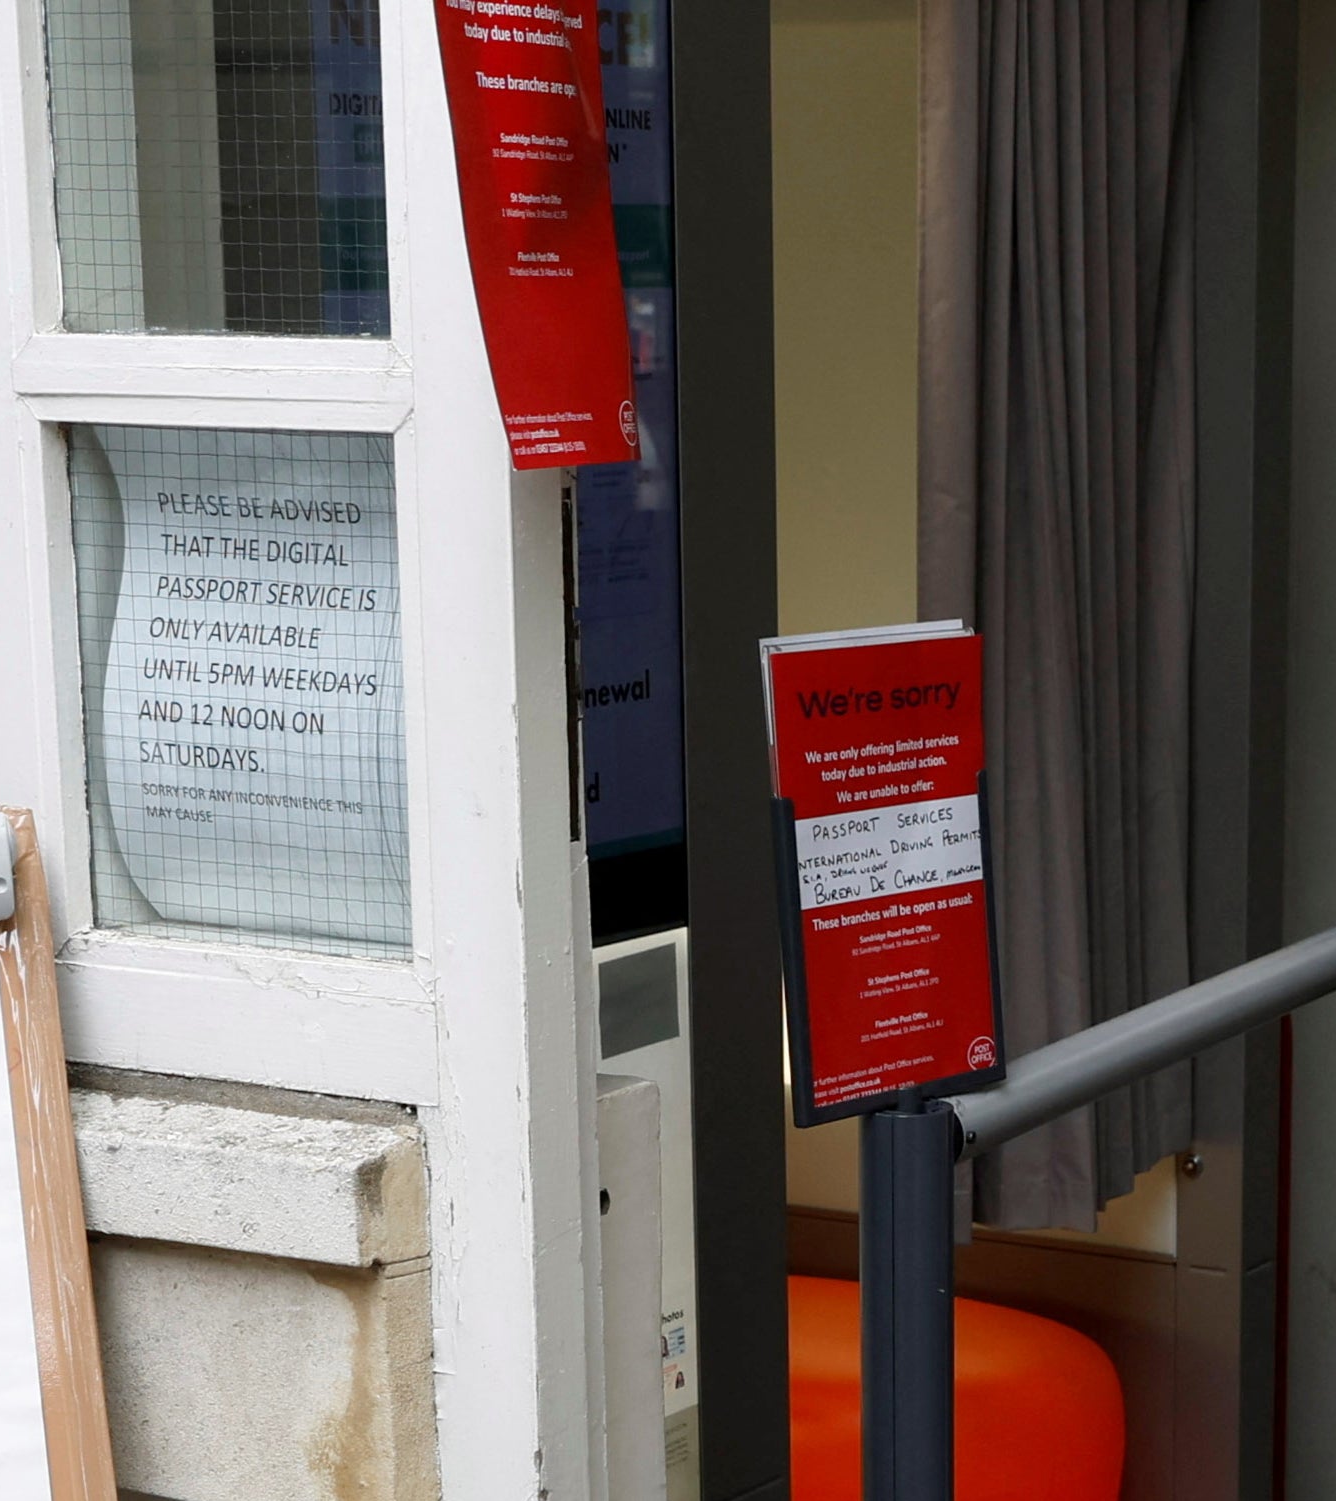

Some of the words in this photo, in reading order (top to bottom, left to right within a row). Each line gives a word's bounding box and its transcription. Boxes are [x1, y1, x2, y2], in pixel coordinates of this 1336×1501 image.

[477, 0, 532, 18] experience
[534, 4, 561, 24] delays
[464, 22, 489, 43] today
[491, 25, 511, 42] due
[513, 28, 525, 43] to
[526, 28, 564, 48] industrial
[475, 71, 505, 89] These
[507, 74, 549, 92] branches
[550, 82, 563, 95] are
[605, 107, 652, 131] NLINE
[157, 492, 232, 517] PLEASE
[237, 496, 264, 519] BE
[270, 499, 362, 525] ADVISED
[161, 533, 215, 558] THAT
[221, 537, 260, 561] THE
[267, 540, 349, 566] DIGITAL
[157, 576, 263, 604] PASSPORT
[266, 582, 352, 610] SERVICE
[357, 589, 377, 612] IS
[149, 616, 203, 641] ONLY
[207, 621, 321, 650] AVAILABLE
[143, 658, 203, 683] UNTIL
[208, 663, 255, 687] 5PM
[262, 665, 378, 696] WEEKDAYS
[584, 669, 650, 709] newal
[797, 687, 884, 719] We're
[890, 682, 961, 710] sorry
[138, 700, 183, 723] AND
[190, 703, 214, 726] 12
[220, 705, 285, 732] NOON
[292, 711, 325, 735] ON
[139, 740, 265, 773] SATURDAYS.
[804, 750, 821, 764] We
[823, 751, 838, 761] are
[839, 746, 859, 760] only
[859, 743, 894, 756] offering
[895, 737, 923, 751] limited
[924, 734, 959, 748] services
[820, 768, 846, 781] today
[847, 765, 865, 777] due
[866, 764, 876, 774] to
[878, 757, 916, 774] industrial
[918, 755, 947, 768] action.
[142, 782, 180, 798] SORRY
[183, 786, 207, 800] FOR
[209, 789, 233, 803] ANY
[235, 791, 334, 812] INCONVENIENCE
[337, 800, 363, 814] THIS
[836, 790, 852, 803] We
[853, 790, 867, 800] are
[869, 784, 898, 798] unable
[899, 783, 909, 793] to
[910, 780, 934, 792] offer:
[146, 805, 173, 820] MAY
[176, 808, 214, 823] CAUSE
[812, 816, 880, 842] PASSPORT
[897, 807, 954, 829] SERVICES
[798, 848, 882, 871] NTERNATIONAL
[890, 836, 934, 855] DRIVING
[814, 882, 861, 905] BUREAU
[870, 875, 886, 892] DE
[811, 918, 839, 931] These
[840, 909, 880, 926] branches
[881, 905, 897, 918] will
[898, 903, 911, 915] be
[912, 901, 935, 915] open
[937, 899, 947, 909] as
[948, 892, 973, 906] usual:
[971, 1053, 993, 1064] OFFICE
[974, 1042, 990, 1054] POST
